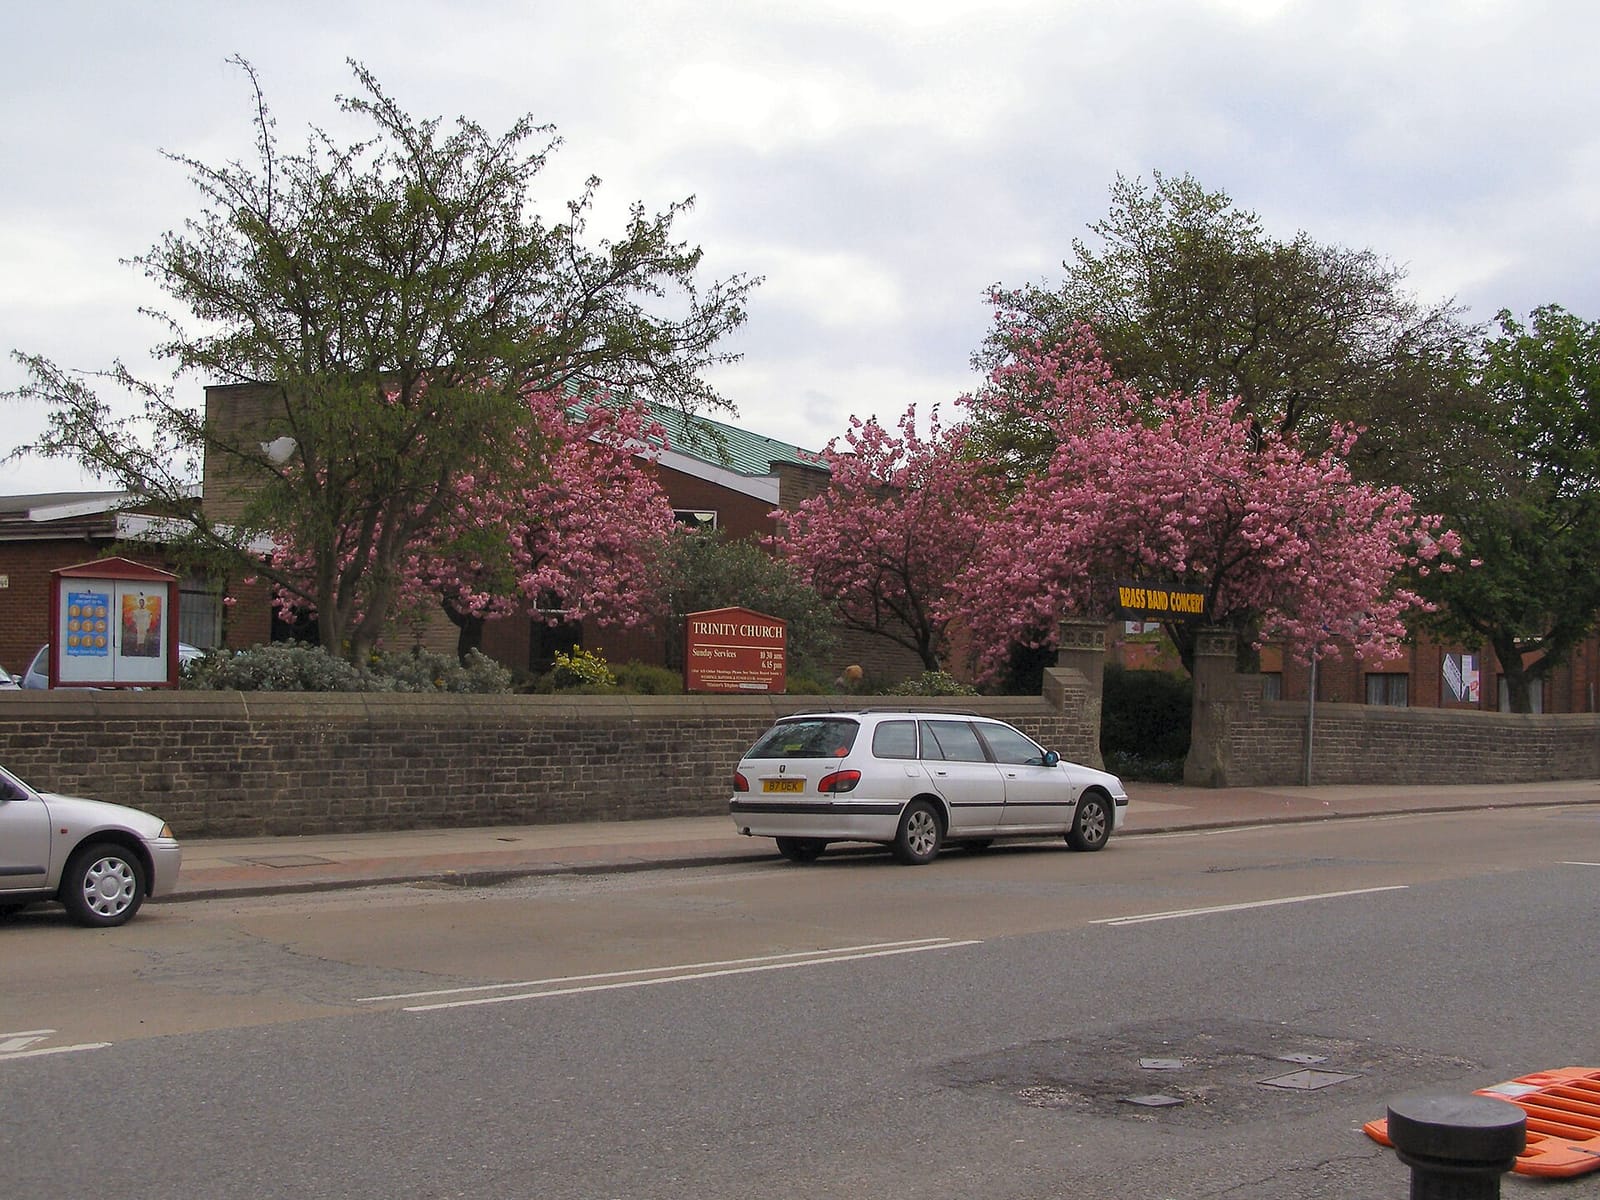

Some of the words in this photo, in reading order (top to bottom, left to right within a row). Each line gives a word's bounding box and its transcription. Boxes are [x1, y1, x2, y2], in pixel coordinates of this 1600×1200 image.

[1119, 587, 1146, 609] BRASS
[1146, 590, 1168, 611] BAND
[1170, 592, 1204, 613] CONCERT
[693, 622, 738, 636] TRINITY
[740, 624, 783, 638] CHURCH
[692, 648, 713, 659] Sunday
[713, 649, 737, 658] Services
